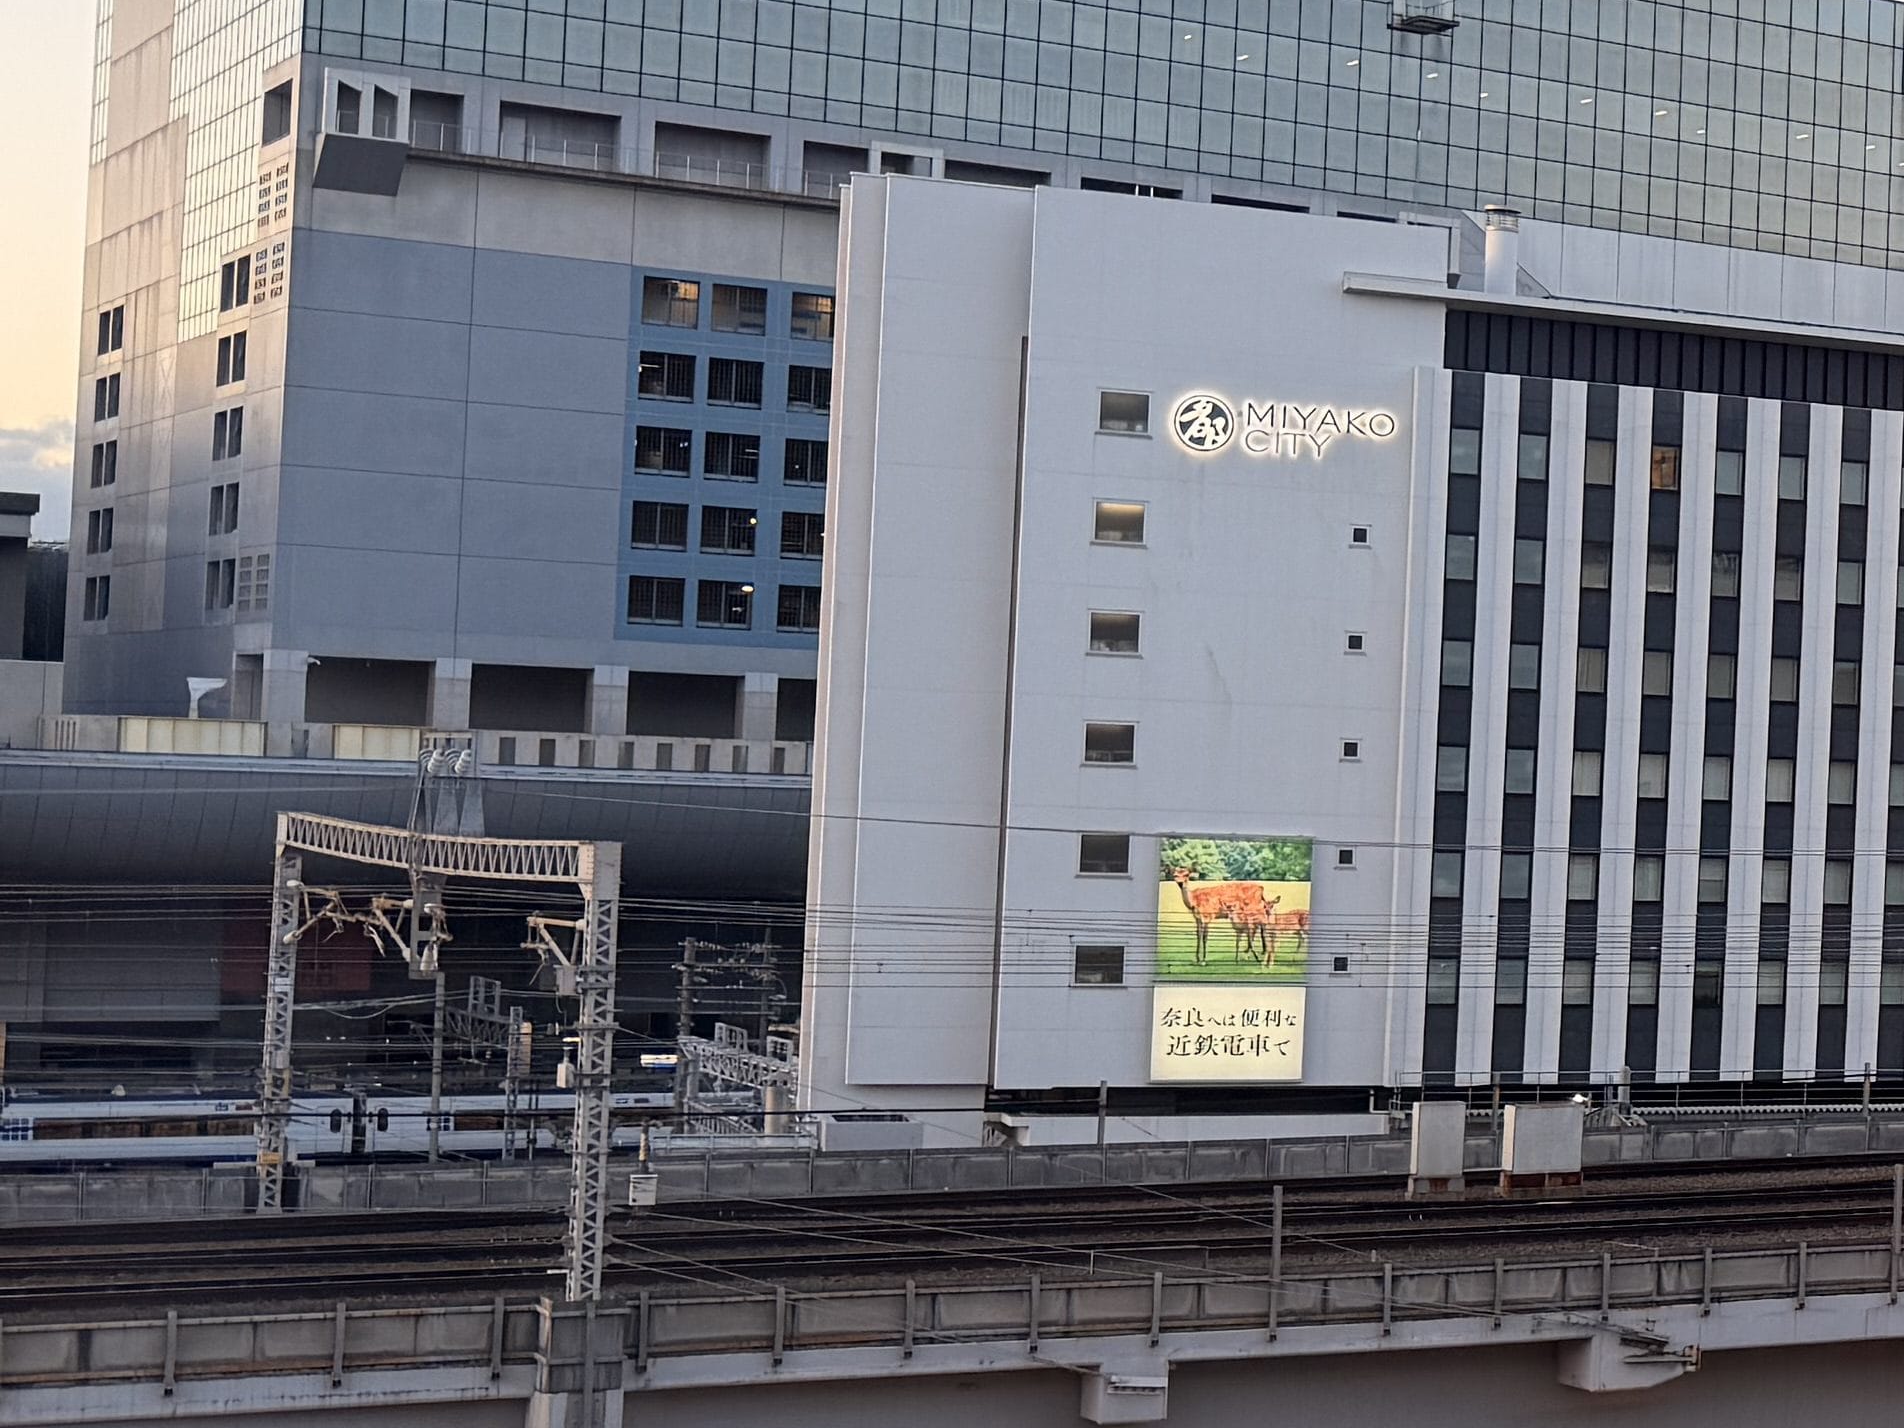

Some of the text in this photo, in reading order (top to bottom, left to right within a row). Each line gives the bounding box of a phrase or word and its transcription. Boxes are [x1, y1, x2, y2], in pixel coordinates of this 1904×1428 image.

[1247, 402, 1397, 438] MIYAKO
[1244, 430, 1334, 458] CITY
[1160, 1006, 1297, 1028] 奈良へは便利な
